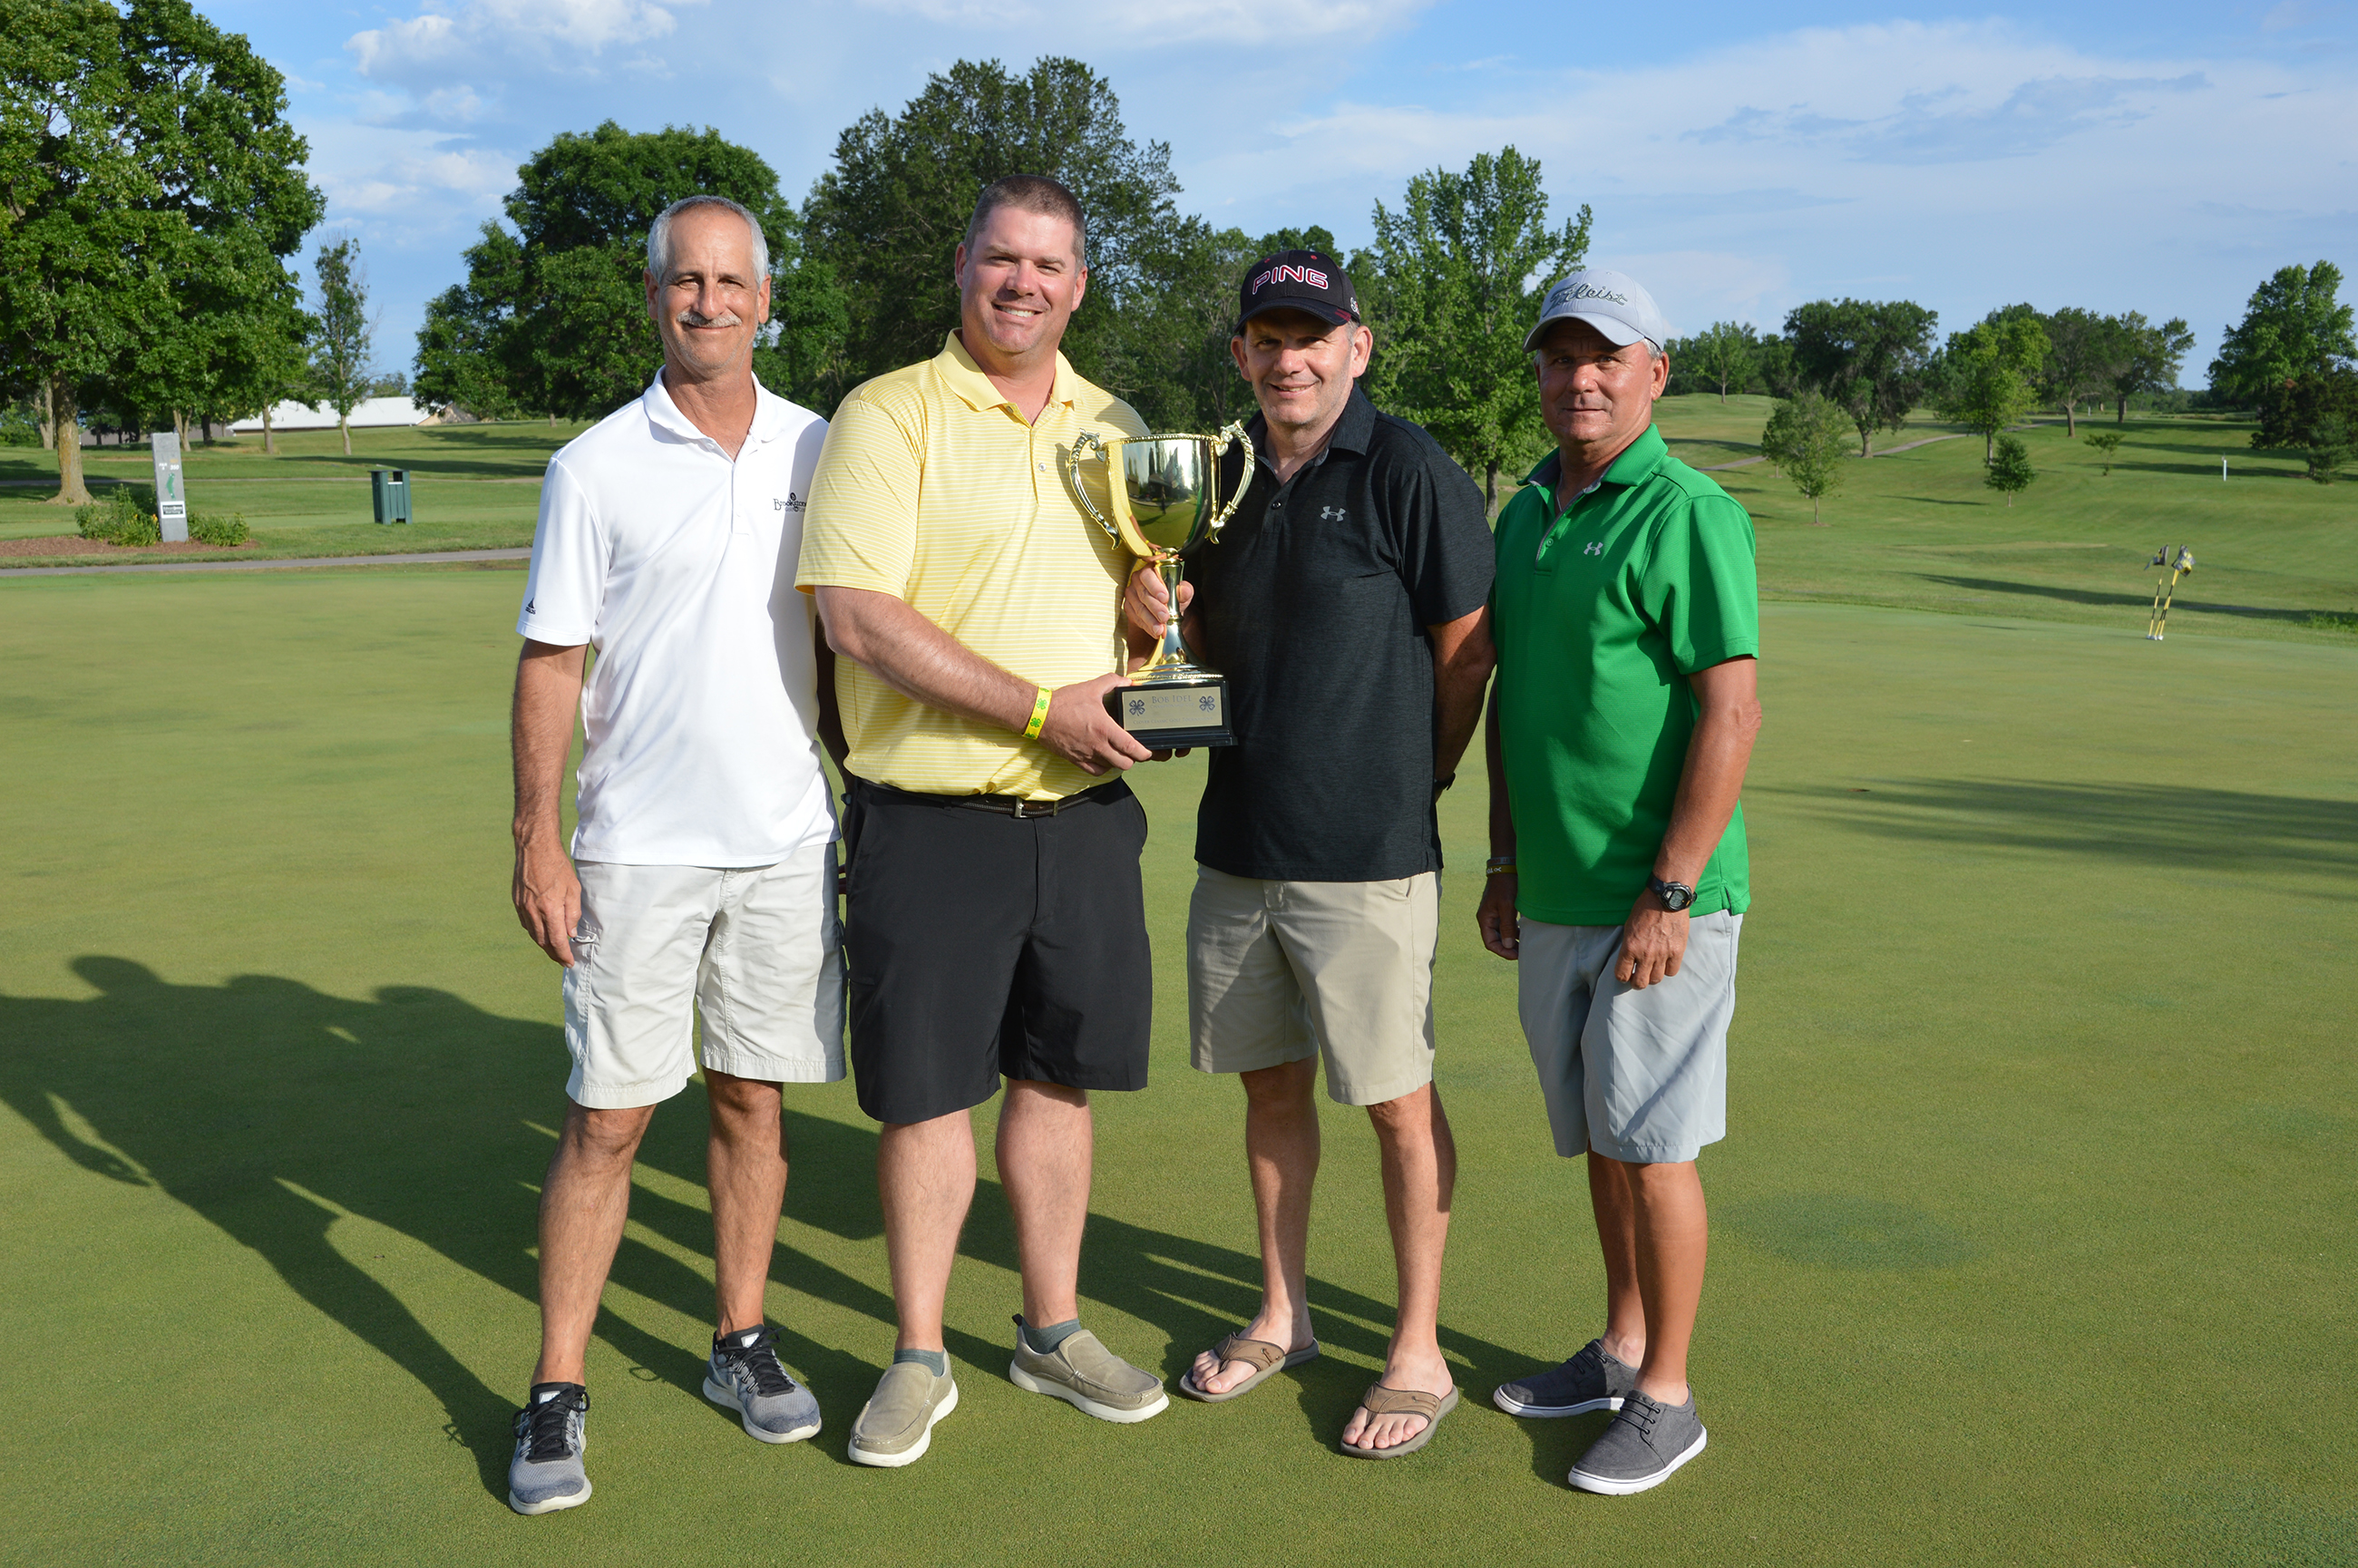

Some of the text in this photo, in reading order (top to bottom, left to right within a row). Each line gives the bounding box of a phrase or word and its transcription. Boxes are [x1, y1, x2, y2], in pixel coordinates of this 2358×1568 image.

[1252, 265, 1329, 295] PING
[1543, 282, 1628, 317] Titleist
[1152, 696, 1170, 704] BOB
